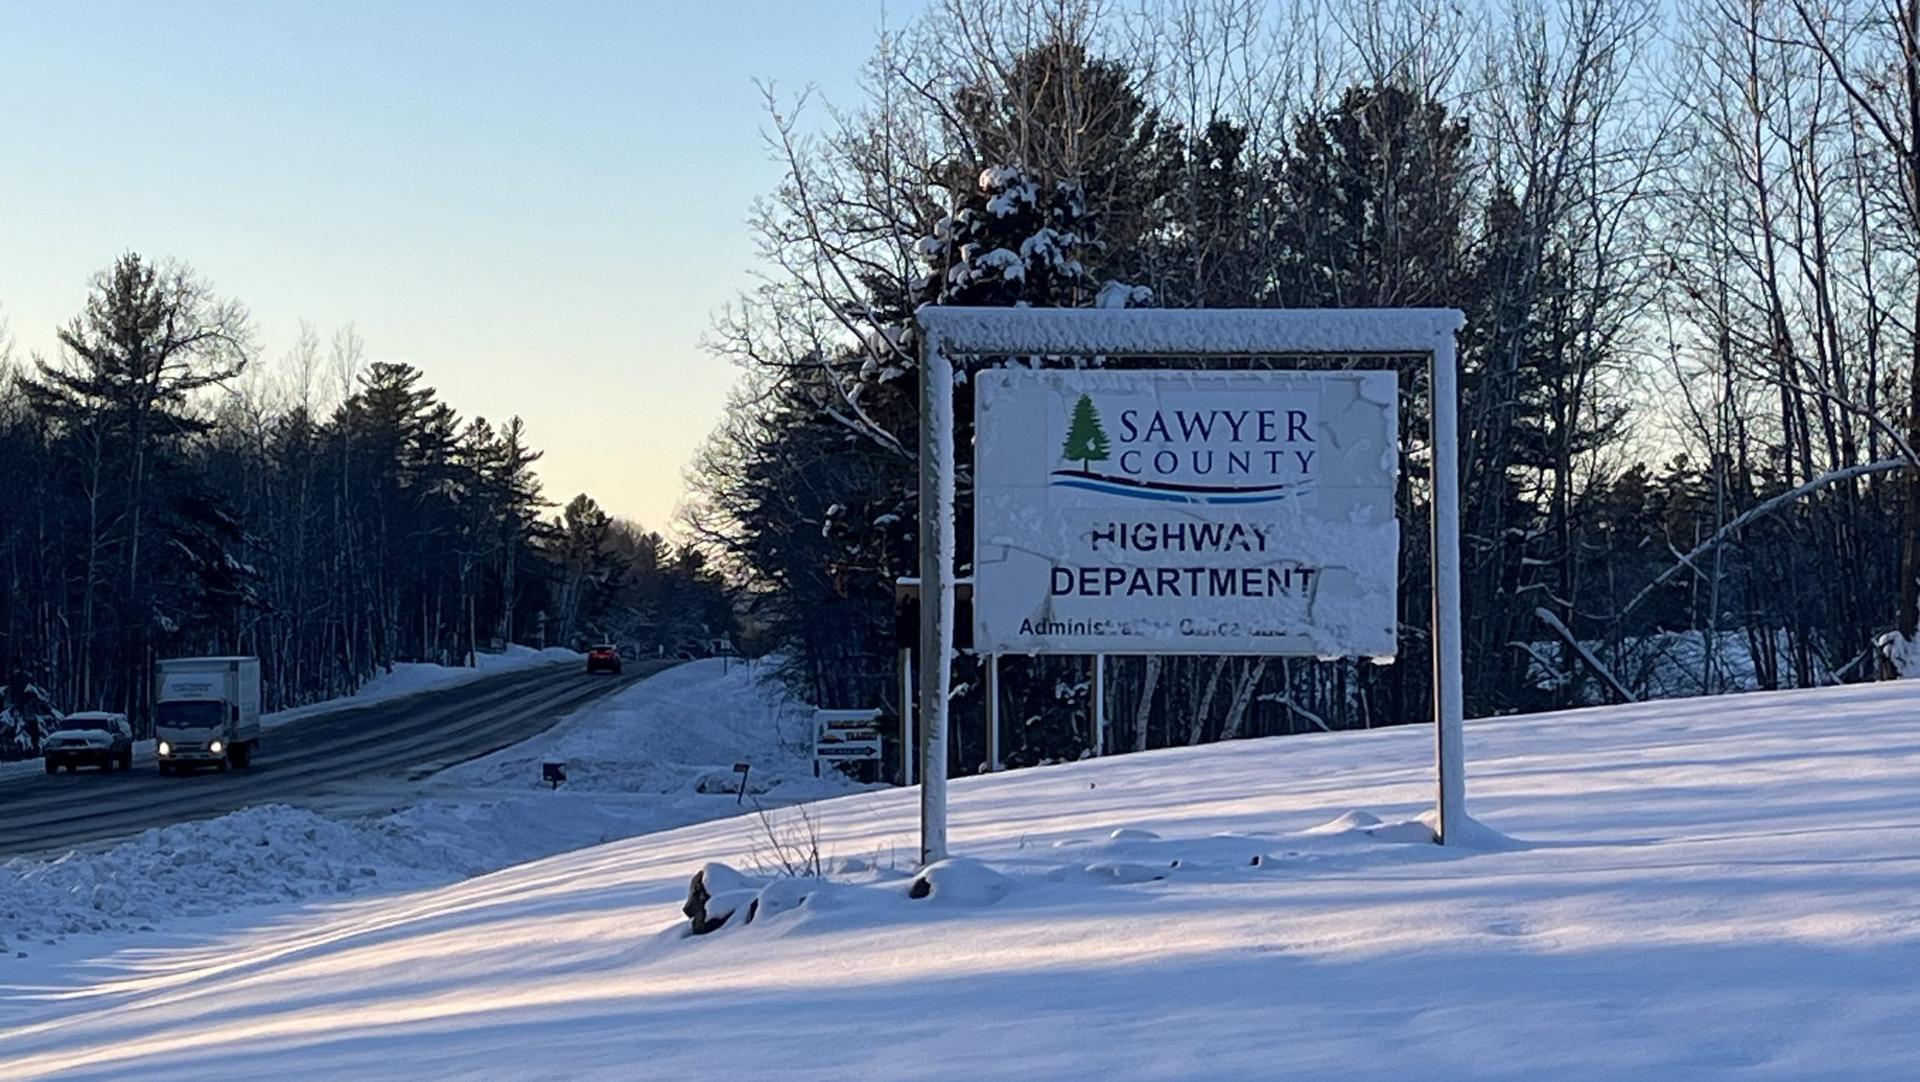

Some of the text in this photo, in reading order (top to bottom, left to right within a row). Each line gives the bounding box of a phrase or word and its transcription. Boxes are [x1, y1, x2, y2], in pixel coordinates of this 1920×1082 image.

[1119, 409, 1316, 443] SAWYER
[1119, 450, 1316, 474] COUNTY
[1092, 522, 1275, 552] HIGHWAY
[1050, 567, 1316, 597] DEPARTMENT
